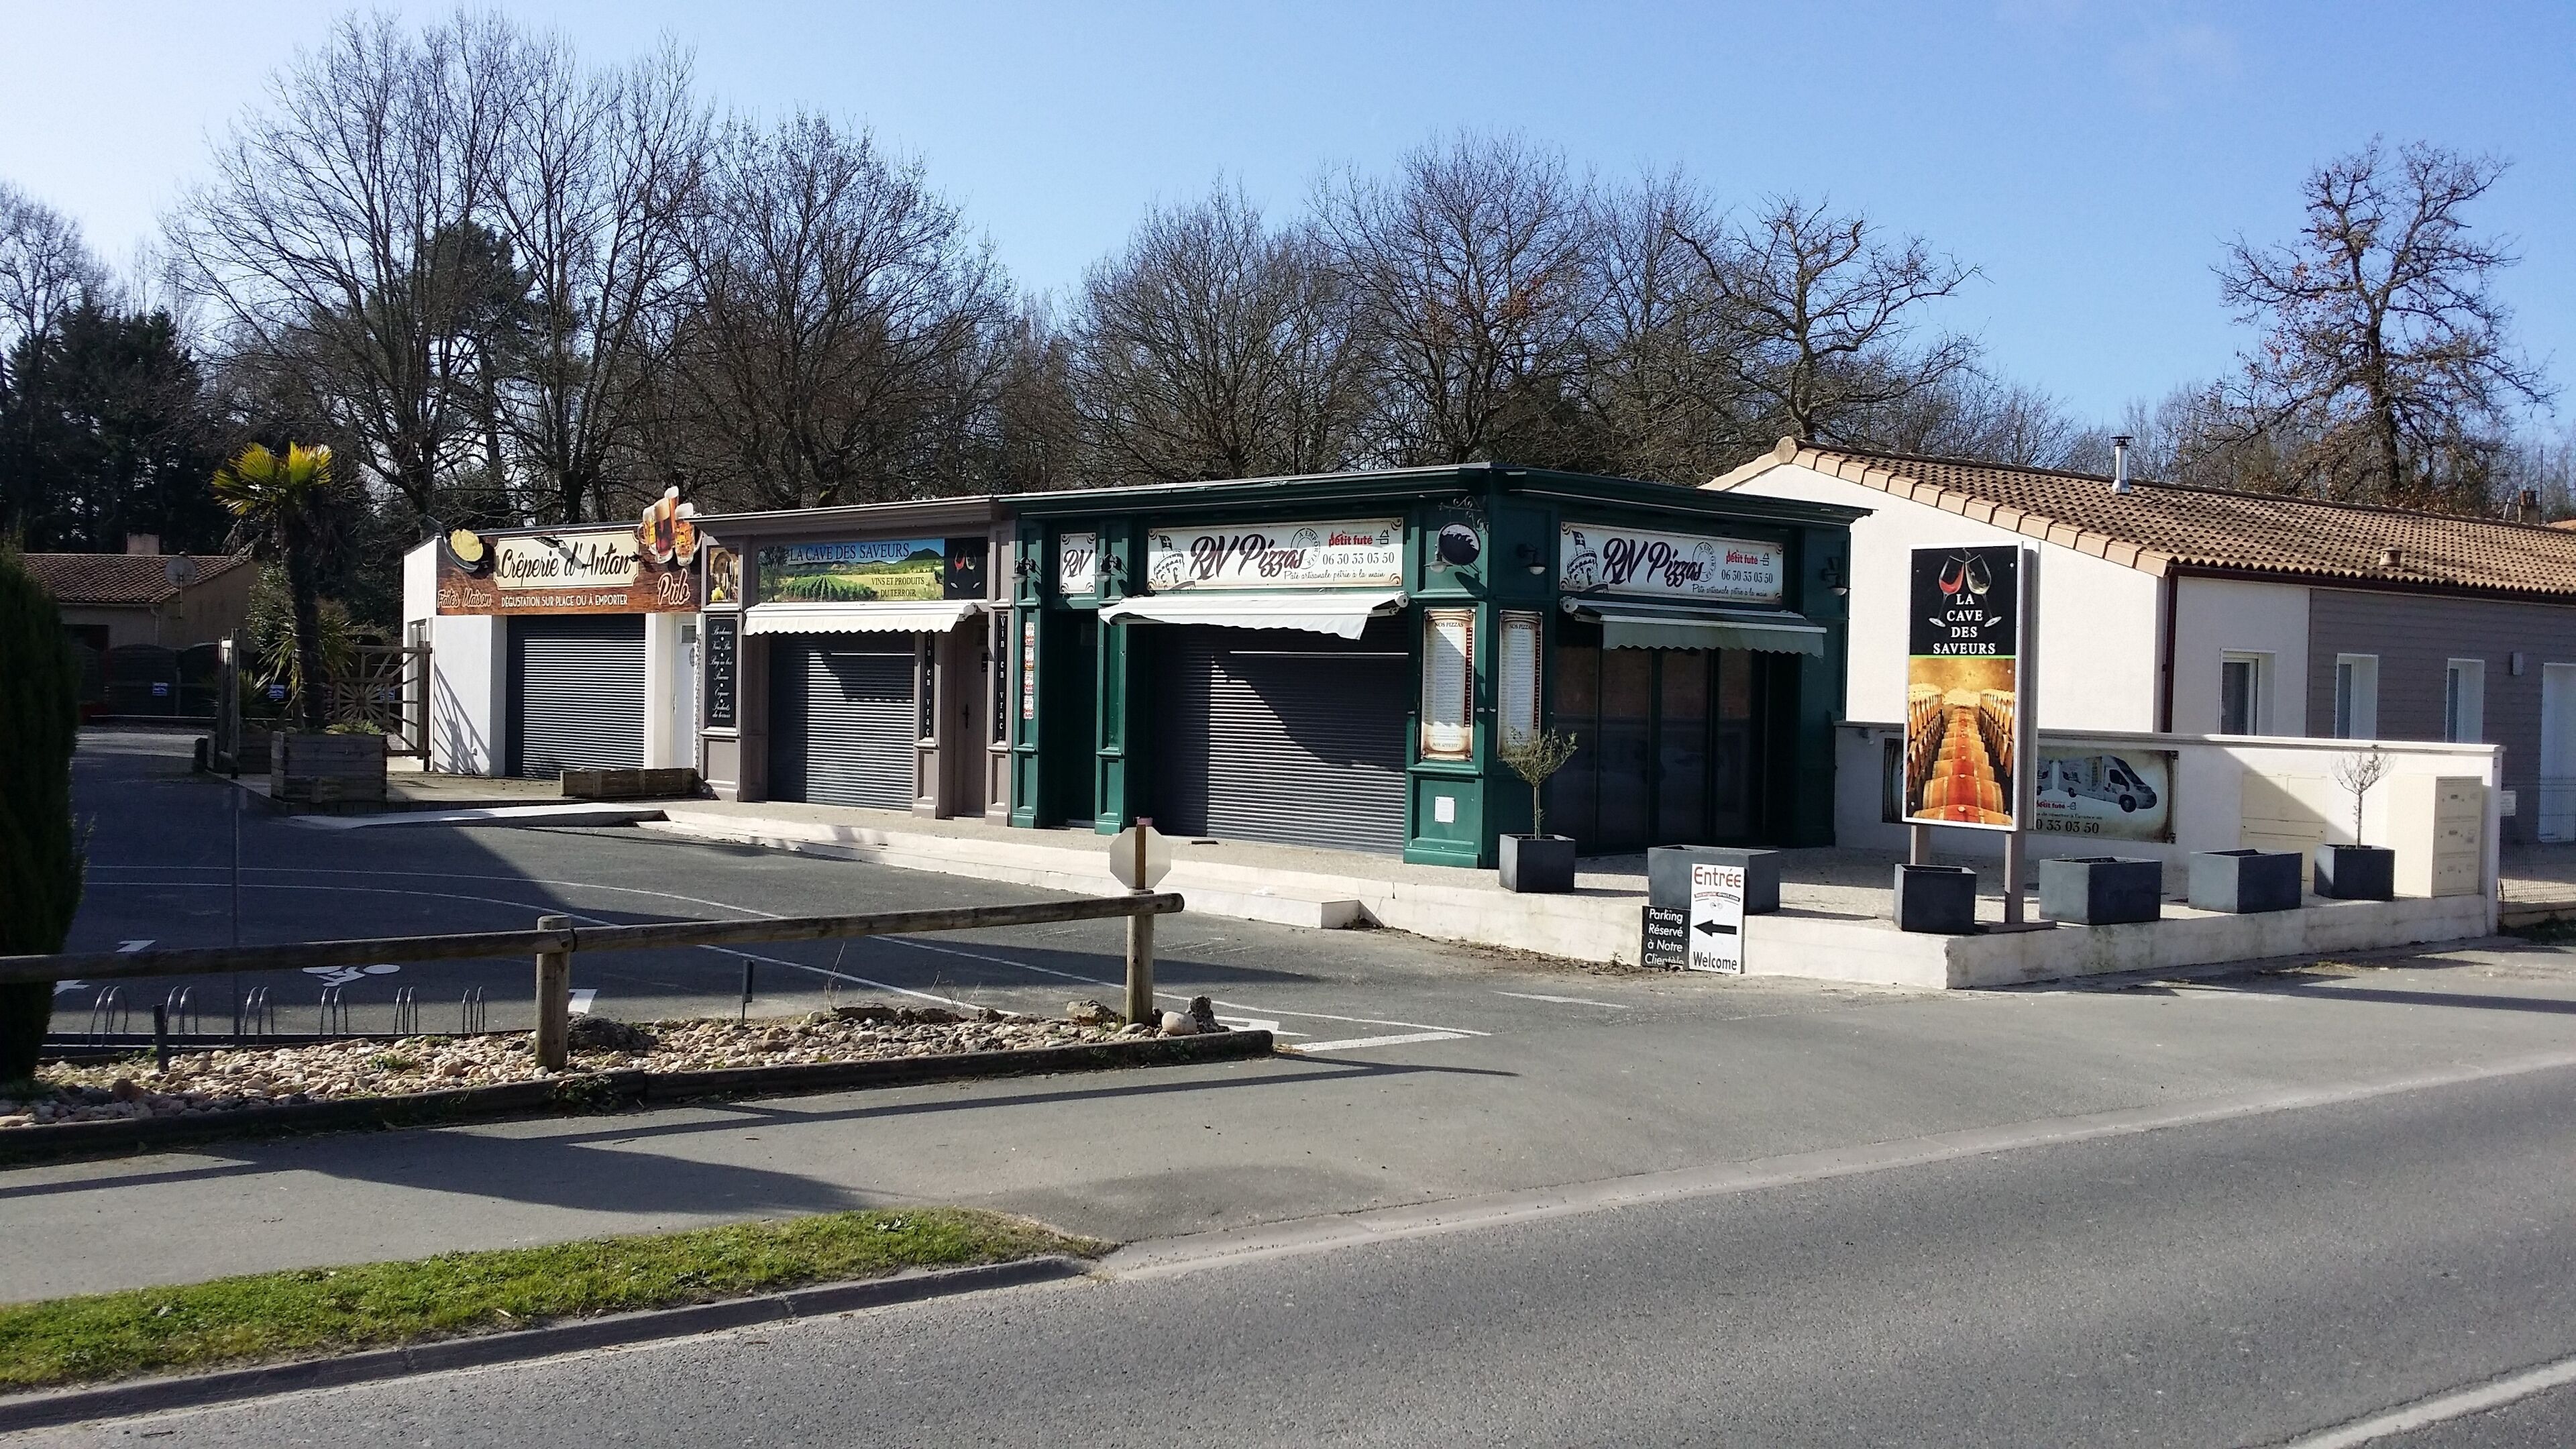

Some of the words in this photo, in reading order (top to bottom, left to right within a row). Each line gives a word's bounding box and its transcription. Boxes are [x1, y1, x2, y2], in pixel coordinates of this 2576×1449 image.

[1354, 535, 1373, 545] futé
[790, 548, 804, 561] LA
[806, 546, 833, 561] CAVE
[836, 545, 856, 559] DES
[860, 543, 910, 558] SAVEURS
[1238, 534, 1307, 578] Pizzas
[1322, 553, 1334, 565] 06
[1337, 553, 1349, 565] 30
[1352, 553, 1364, 564] 33
[1367, 552, 1379, 564] 03
[1382, 551, 1395, 564] 50
[502, 548, 559, 587] Crêperie
[564, 541, 631, 578] d'Antan
[1647, 541, 1704, 588] Pizzas
[1744, 554, 1758, 565] futé
[871, 577, 885, 585] VINS
[887, 577, 894, 585] ET
[895, 577, 924, 585] PRODUITS
[1301, 570, 1332, 580] artisanale
[1358, 569, 1366, 578] la
[1368, 570, 1385, 578] main
[1721, 569, 1730, 580] 06
[1732, 570, 1741, 581] 30
[1743, 571, 1752, 582] 33
[1754, 572, 1762, 583] 03
[1764, 572, 1773, 584] 50
[658, 568, 690, 604] Pub
[891, 588, 916, 596] TERROIR
[437, 589, 460, 608] Faites
[462, 588, 492, 607] Maison
[502, 595, 540, 607] DÉGUSTATION
[542, 596, 555, 606] SUR
[556, 595, 574, 606] PLACE
[576, 595, 586, 606] OU
[588, 594, 594, 606] À
[595, 594, 628, 606] EMPORTER
[1955, 594, 1975, 604] LA
[1947, 610, 1983, 621] CAVE
[1951, 627, 1978, 637] DES
[1933, 643, 1996, 654] SAVEURS
[1000, 661, 1004, 678] en
[926, 669, 930, 686] en
[2047, 819, 2061, 831] 33
[2065, 820, 2080, 833] 03
[2084, 822, 2099, 834] 50
[1694, 866, 1741, 888] Entrée
[1649, 908, 1683, 924] Parking
[1648, 923, 1683, 937] Réservé
[1648, 938, 1654, 949] à
[1656, 939, 1683, 952] Notre
[1693, 951, 1737, 970] Welcome
